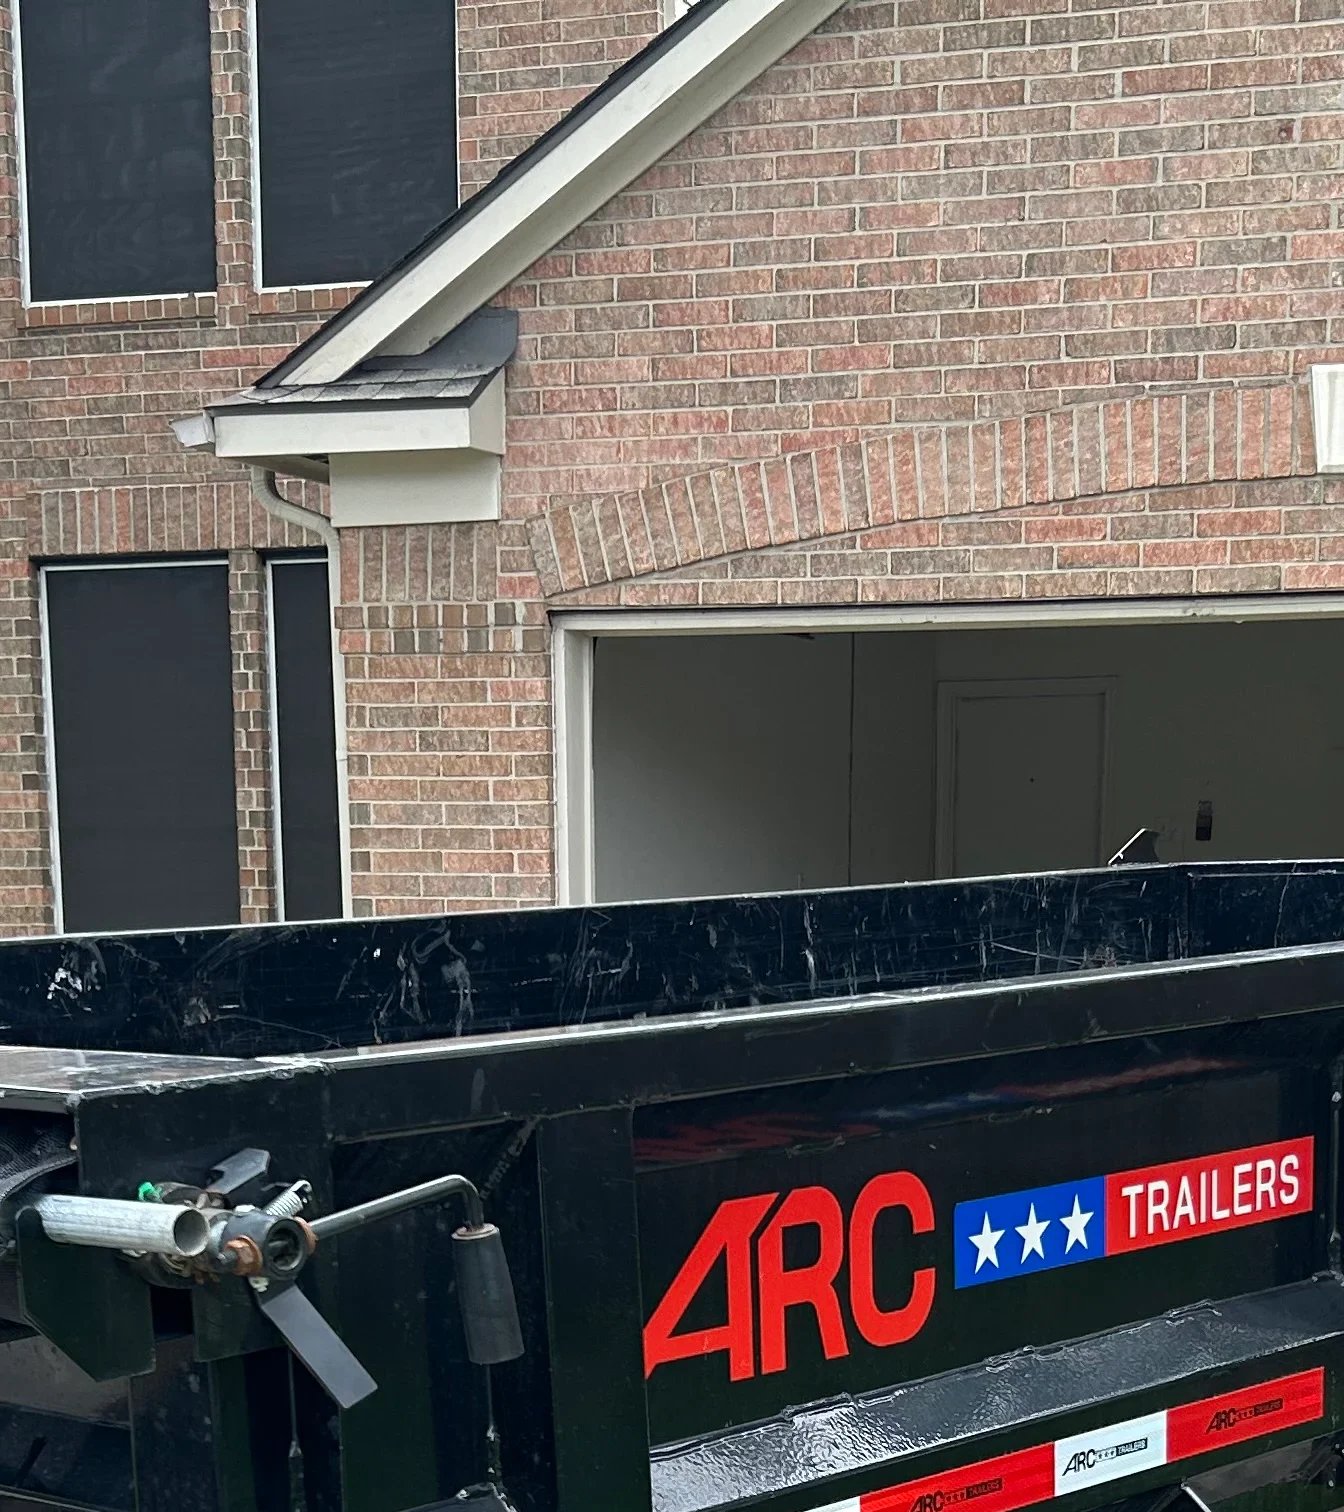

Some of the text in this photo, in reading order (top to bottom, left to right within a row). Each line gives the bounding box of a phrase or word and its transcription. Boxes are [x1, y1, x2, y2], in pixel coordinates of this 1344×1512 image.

[643, 1152, 1301, 1383] ARC TRAILERS
[1206, 1407, 1236, 1435] ARC
[1062, 1439, 1147, 1477] ARC TRAILERS
